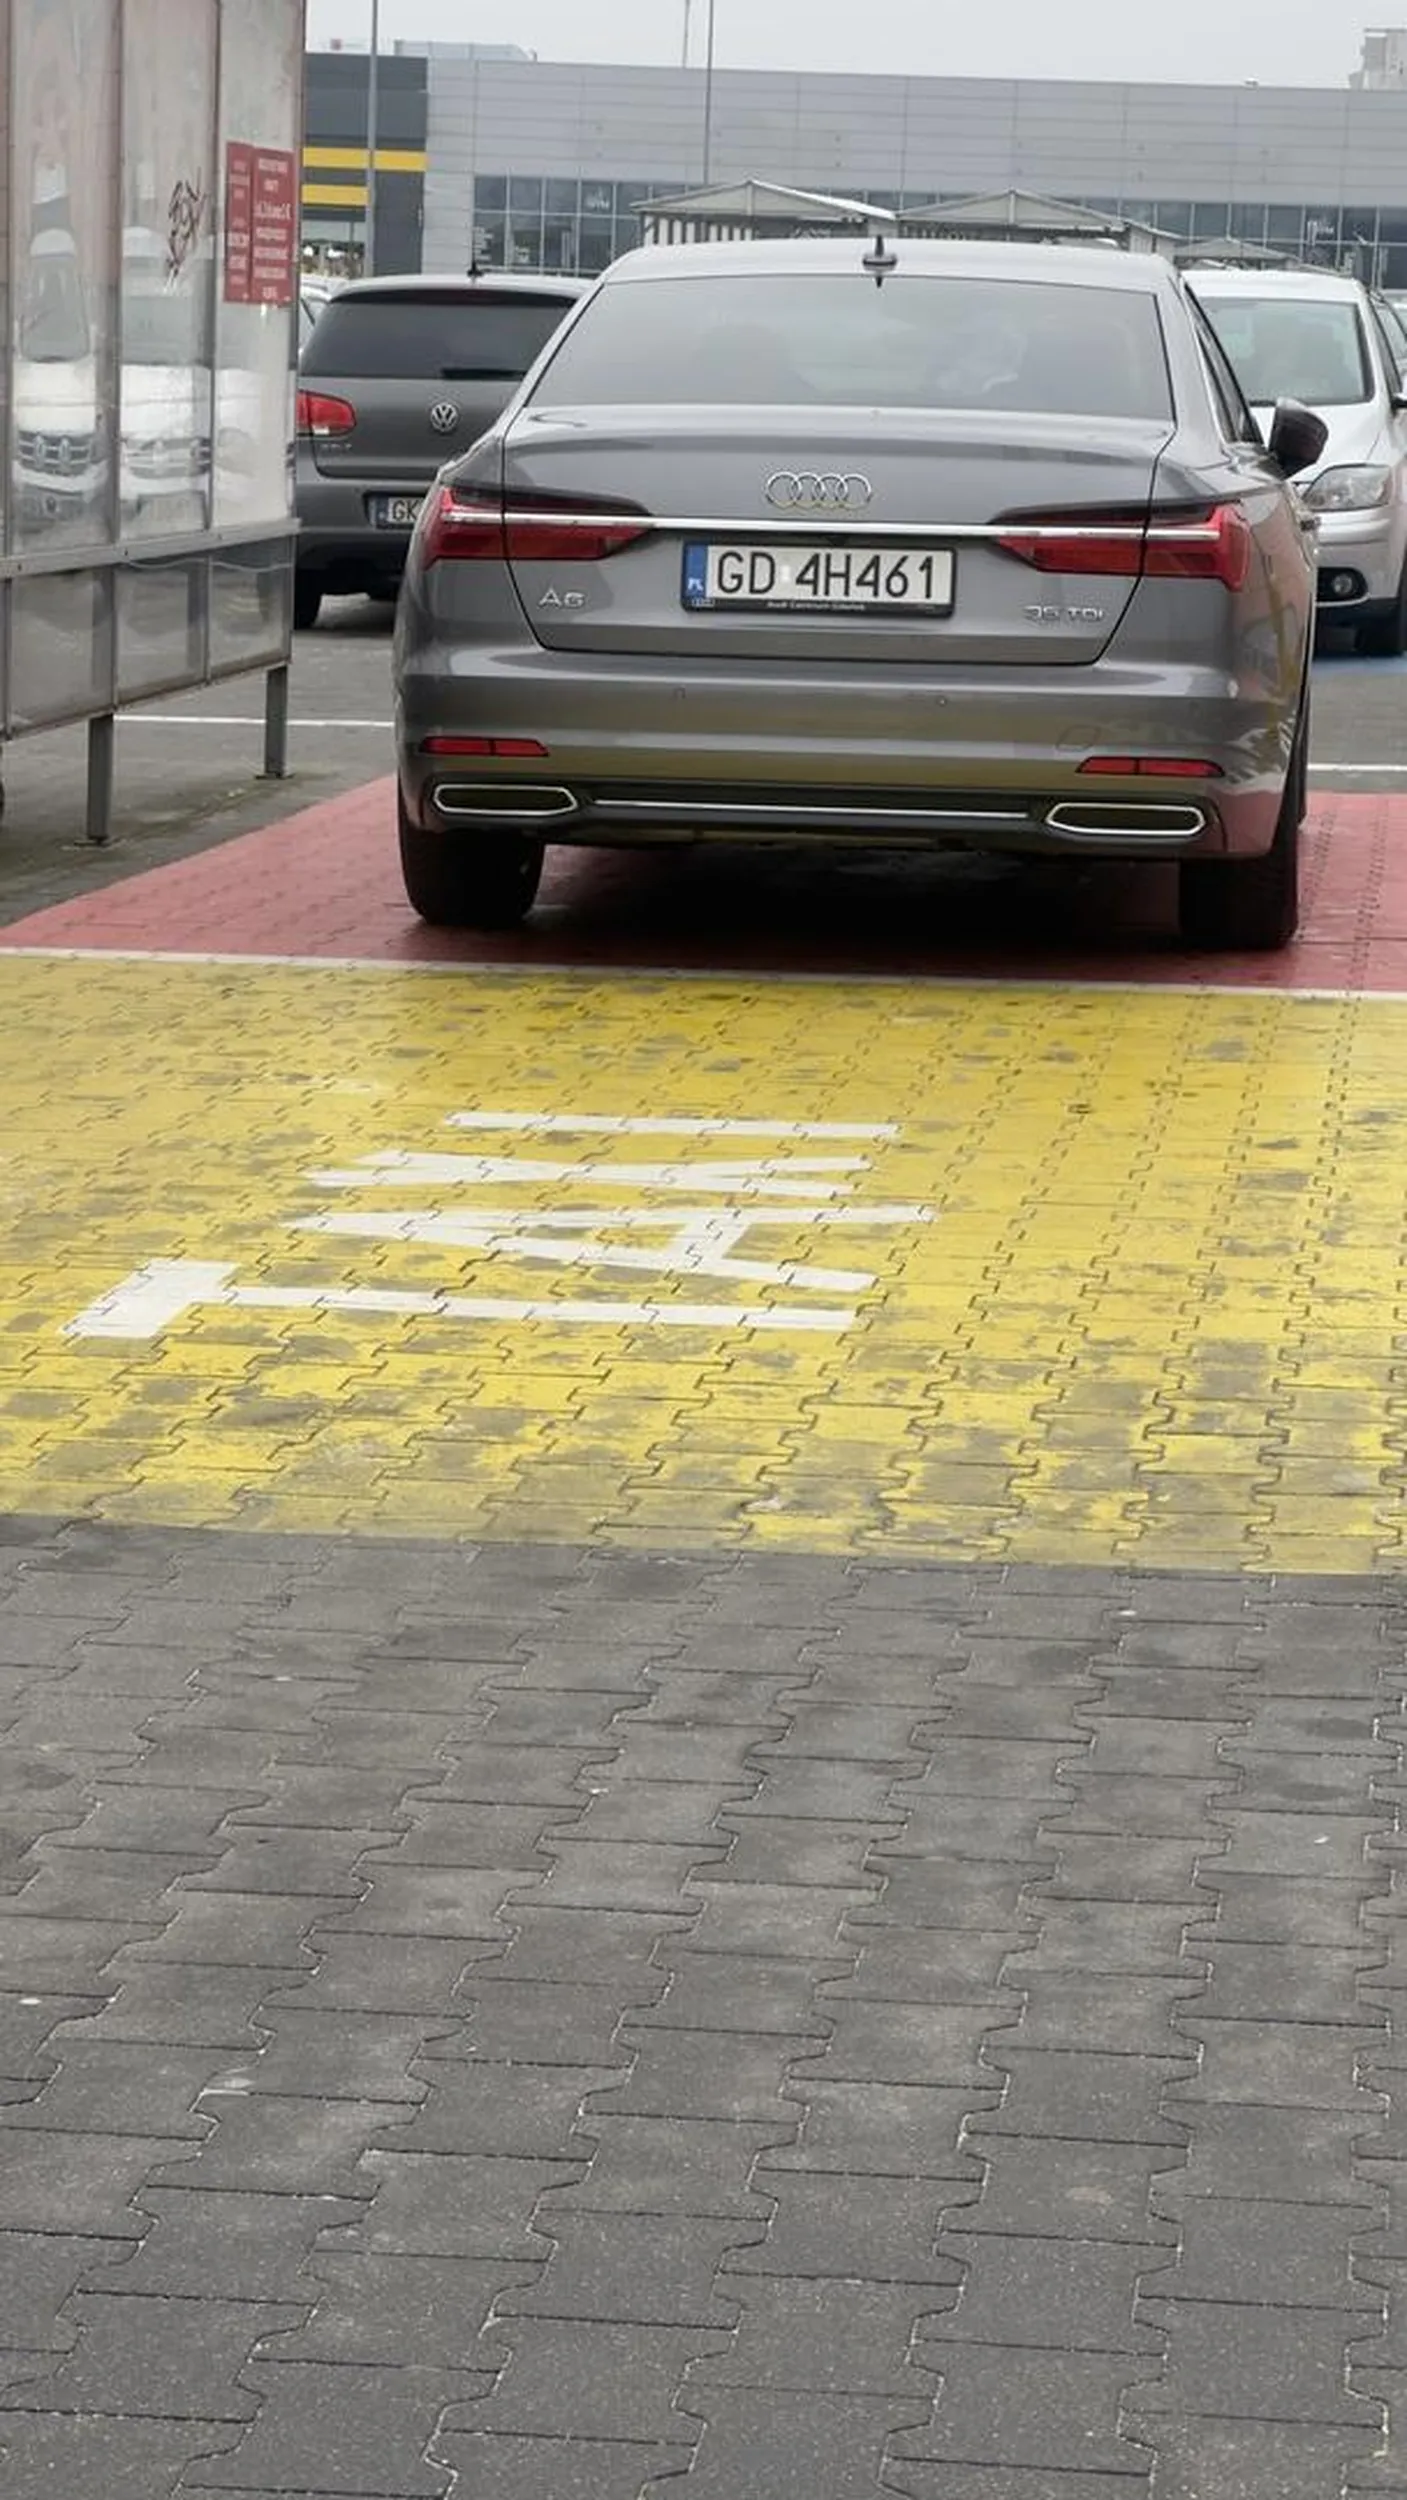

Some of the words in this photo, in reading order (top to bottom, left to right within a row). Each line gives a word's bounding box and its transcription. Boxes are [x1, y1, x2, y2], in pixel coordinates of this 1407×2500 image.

[717, 551, 776, 595] GD
[796, 553, 934, 600] 4H461
[538, 588, 585, 608] A6
[1023, 605, 1060, 620] 35
[1067, 607, 1104, 620] TDI
[58, 1111, 938, 1338] TAXI
